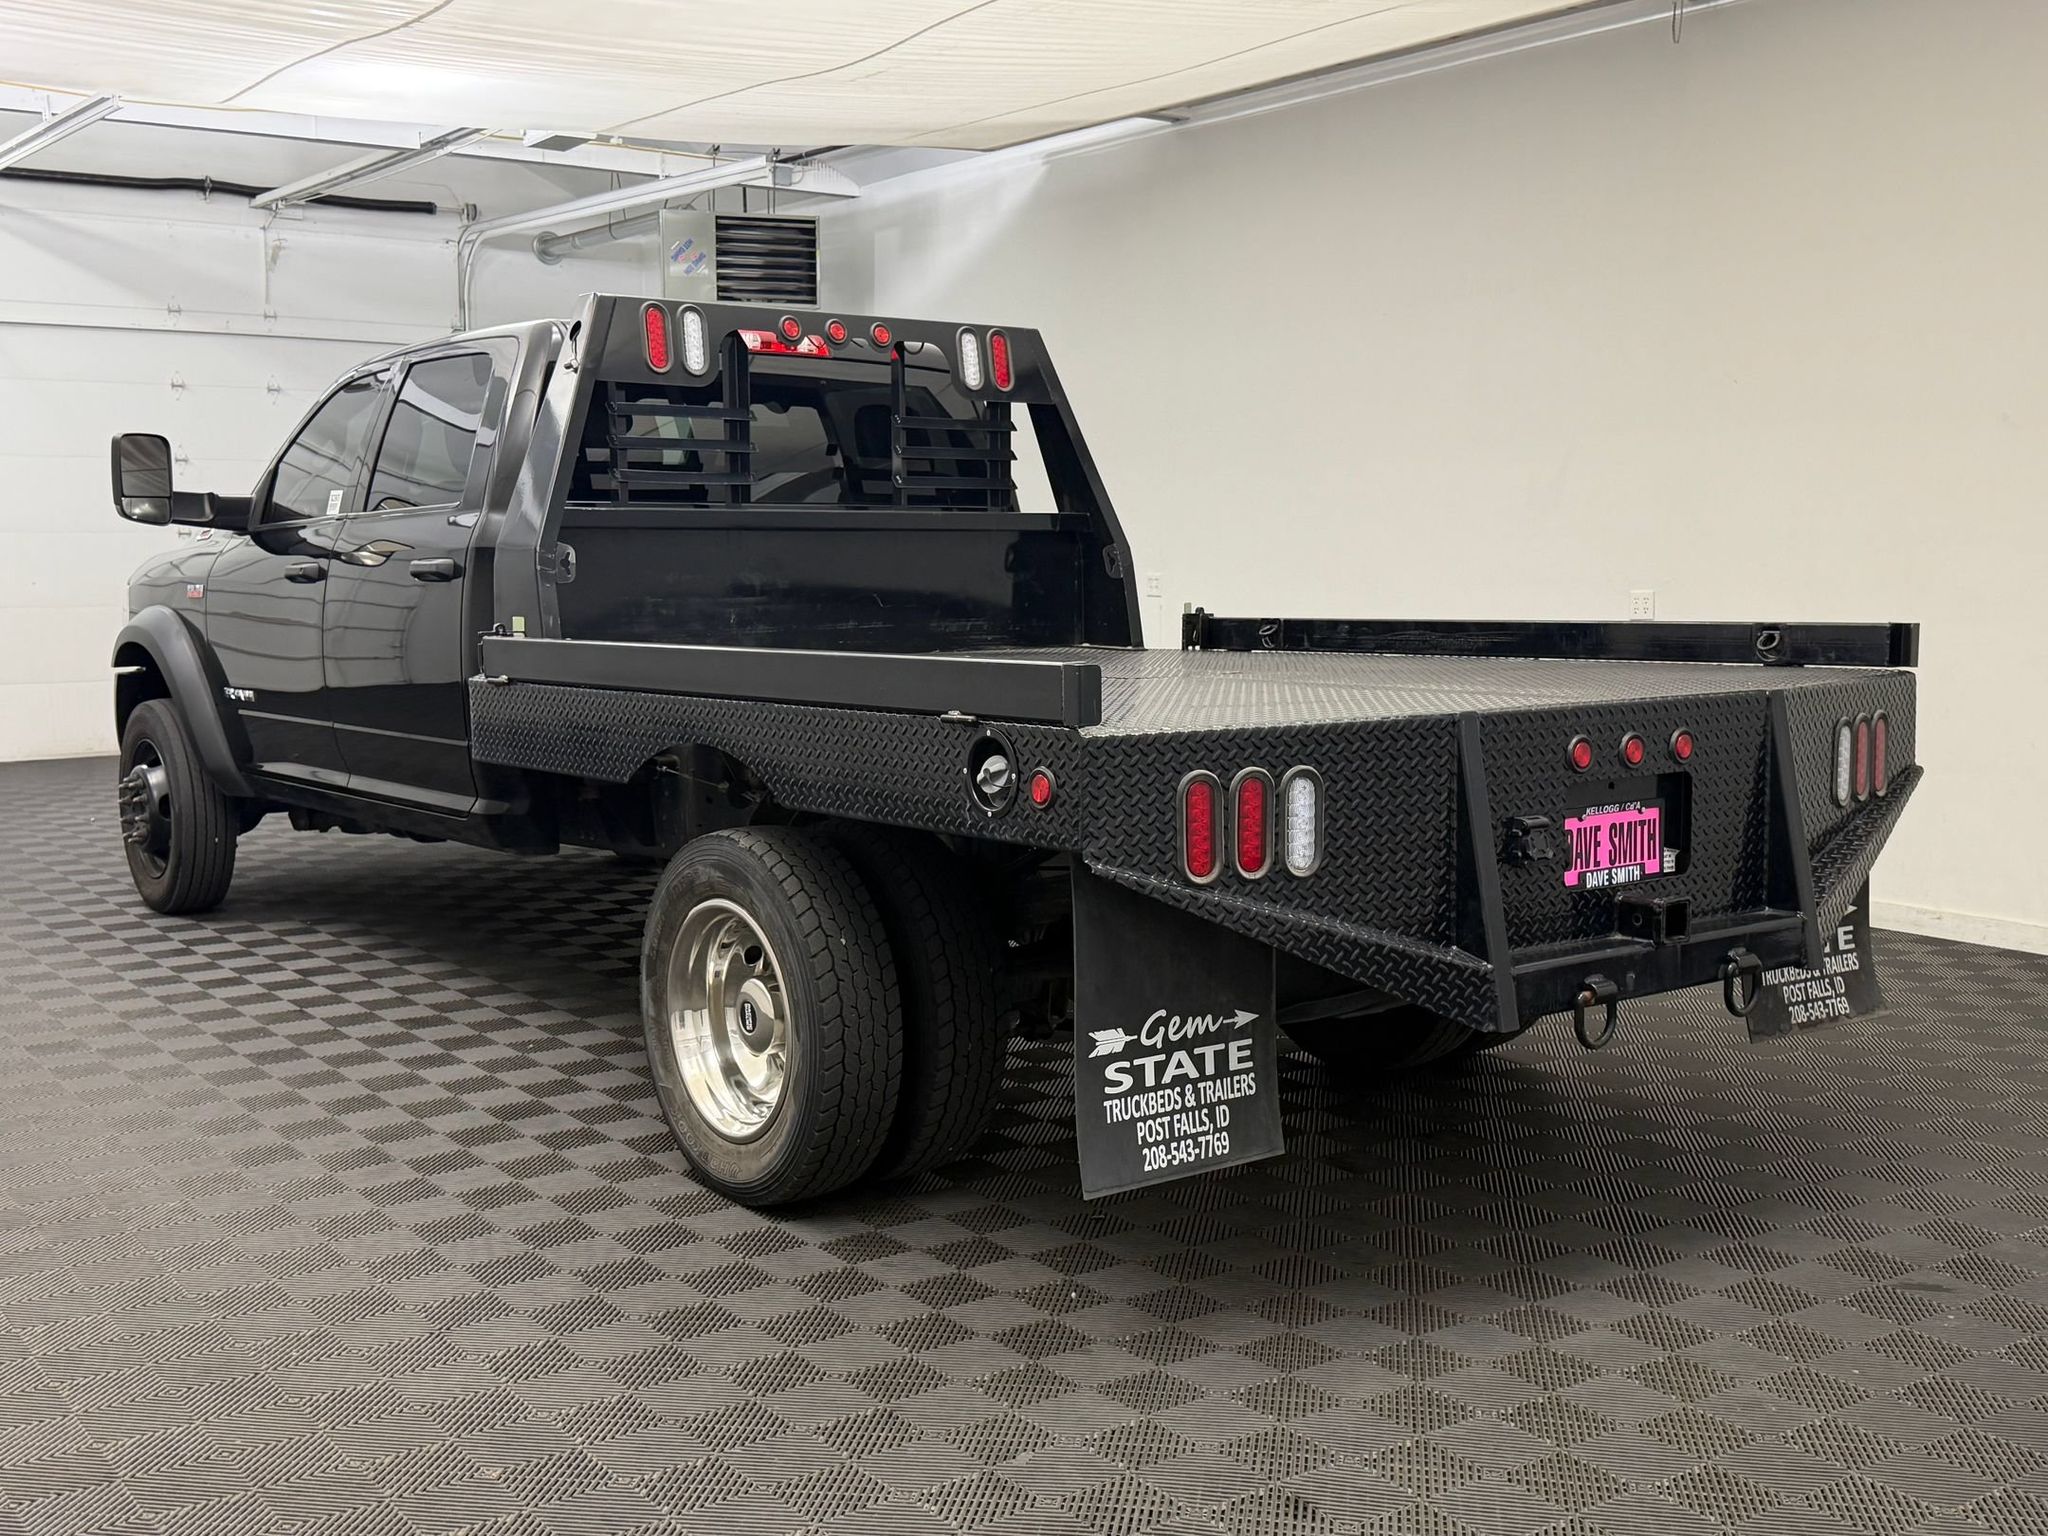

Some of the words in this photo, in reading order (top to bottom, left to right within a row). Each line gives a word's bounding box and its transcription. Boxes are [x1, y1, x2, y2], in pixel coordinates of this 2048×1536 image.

[1585, 803, 1620, 816] KELLOGG
[1608, 817, 1657, 867] SMITH
[1586, 869, 1610, 889] DAVE
[1611, 865, 1640, 885] SMITH
[1782, 982, 1807, 1004] POST
[1806, 978, 1836, 1000] FALLS,
[1833, 976, 1846, 994] ID
[1788, 996, 1850, 1025] 208-543-7769
[1140, 1009, 1223, 1050] Gem
[1104, 1038, 1254, 1095] STATE
[1104, 1088, 1182, 1124] TRUCKBEDS
[1184, 1084, 1197, 1108] &
[1198, 1072, 1257, 1105] TRAILERS
[1137, 1116, 1171, 1146] POST
[1174, 1109, 1214, 1138] FALLS,
[1216, 1105, 1230, 1129] ID
[1142, 1131, 1230, 1172] 208-543-7769
